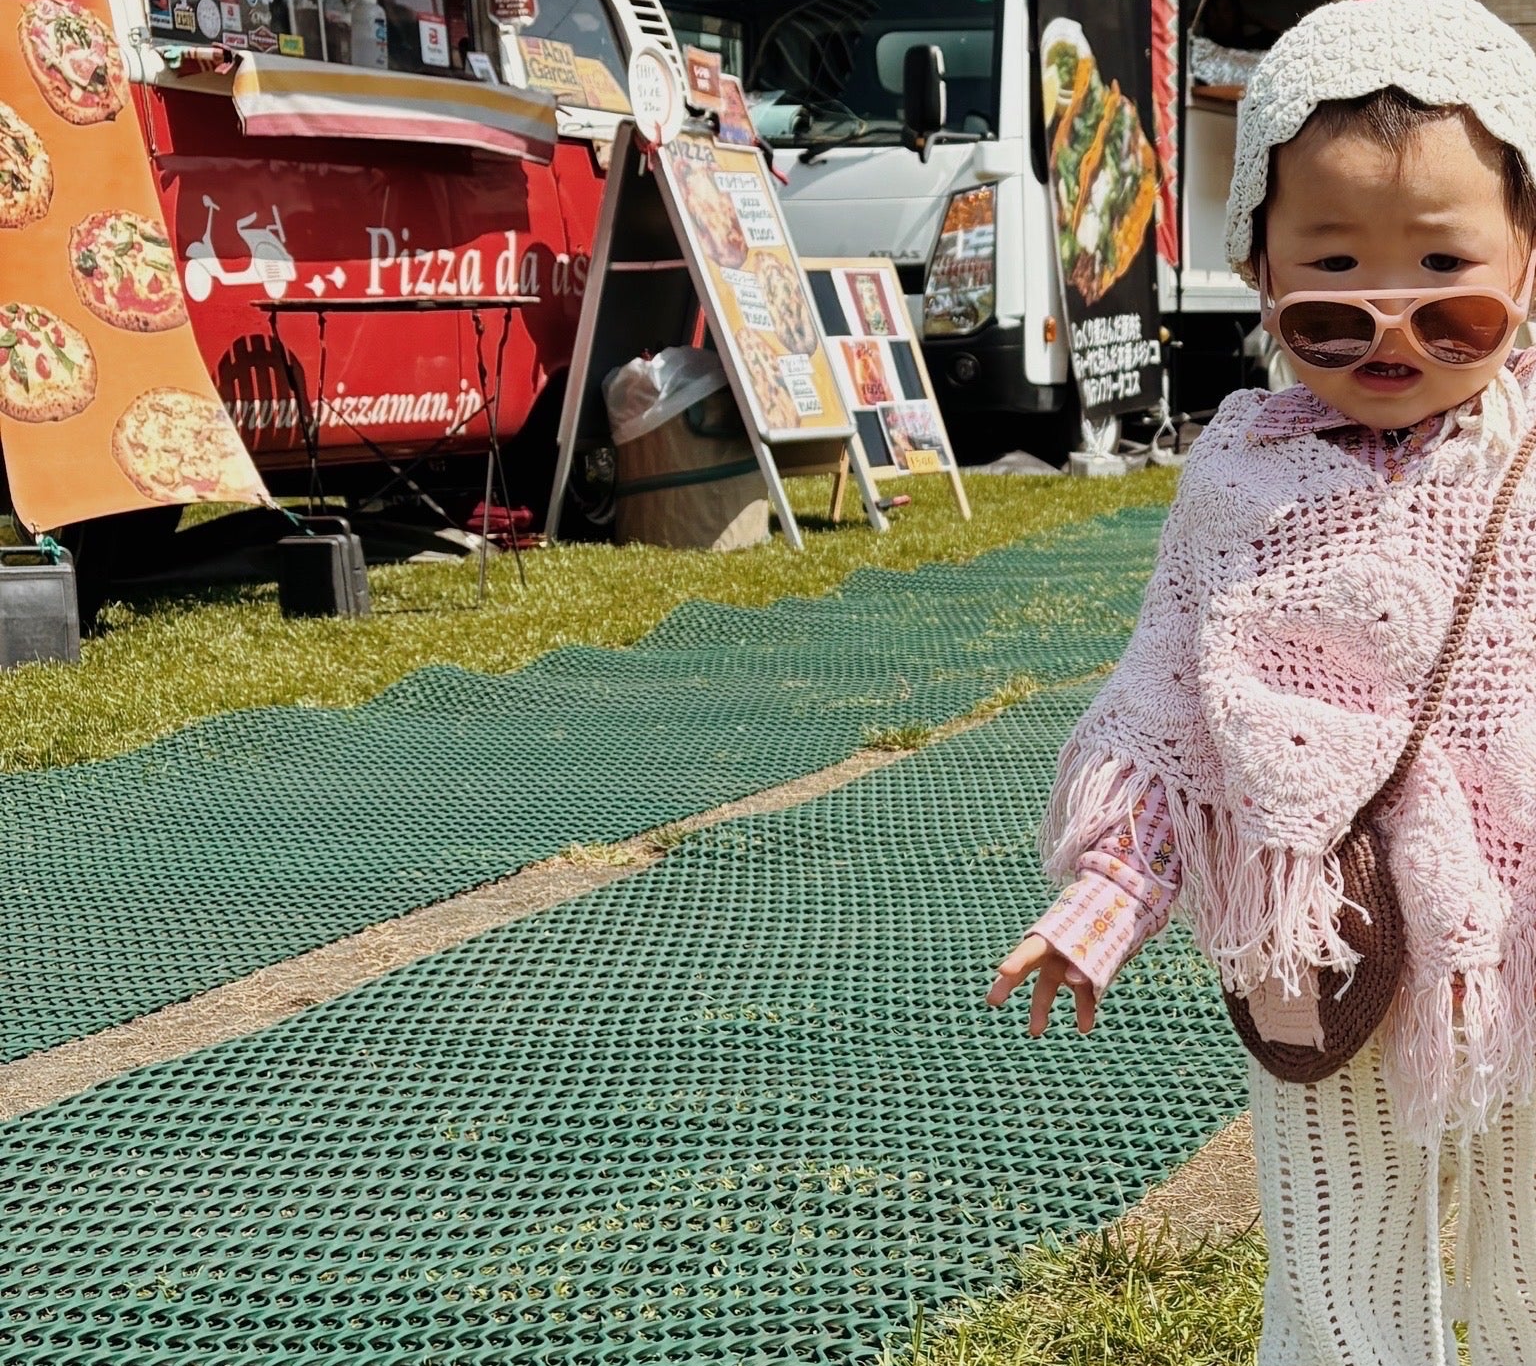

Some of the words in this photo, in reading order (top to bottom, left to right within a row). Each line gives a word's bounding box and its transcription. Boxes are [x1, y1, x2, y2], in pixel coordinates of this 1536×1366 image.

[529, 57, 579, 85] Garcia
[665, 138, 716, 163] pizza
[365, 227, 484, 296] Pizza
[496, 230, 540, 296] da
